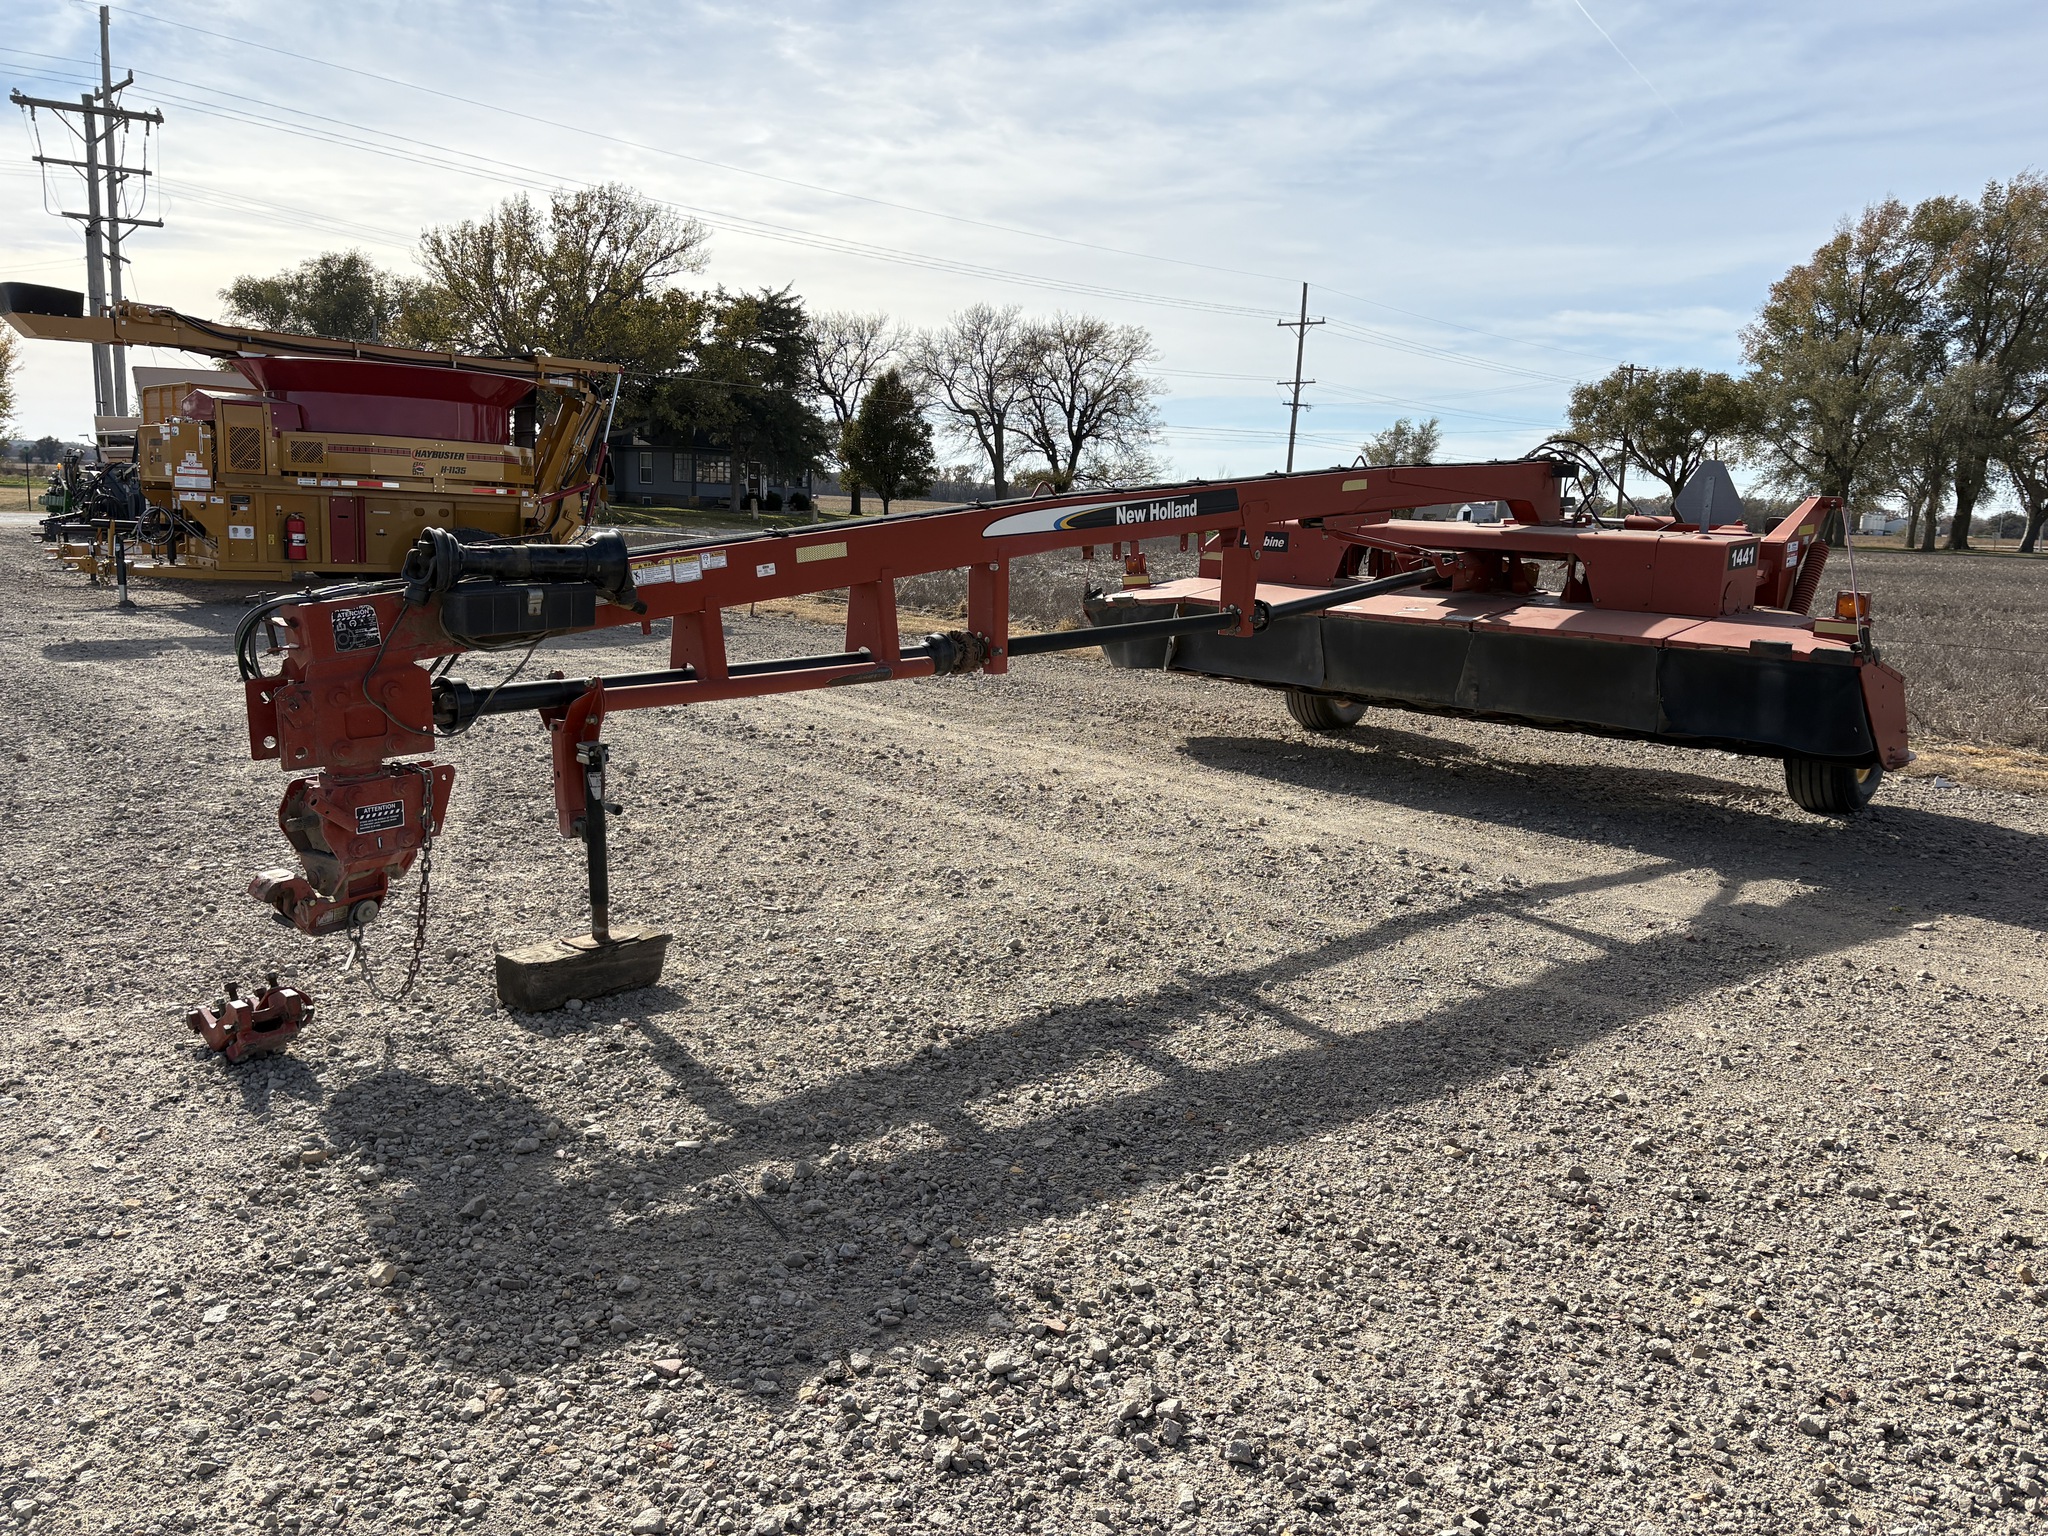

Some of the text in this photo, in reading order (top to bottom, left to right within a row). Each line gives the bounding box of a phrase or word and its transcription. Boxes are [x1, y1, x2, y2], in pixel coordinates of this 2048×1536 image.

[415, 449, 465, 461] HAYBUSTER
[440, 465, 467, 475] H-1135
[1116, 499, 1198, 525] New Holland
[1731, 546, 1755, 567] 1441
[364, 803, 396, 813] ATTENTION
